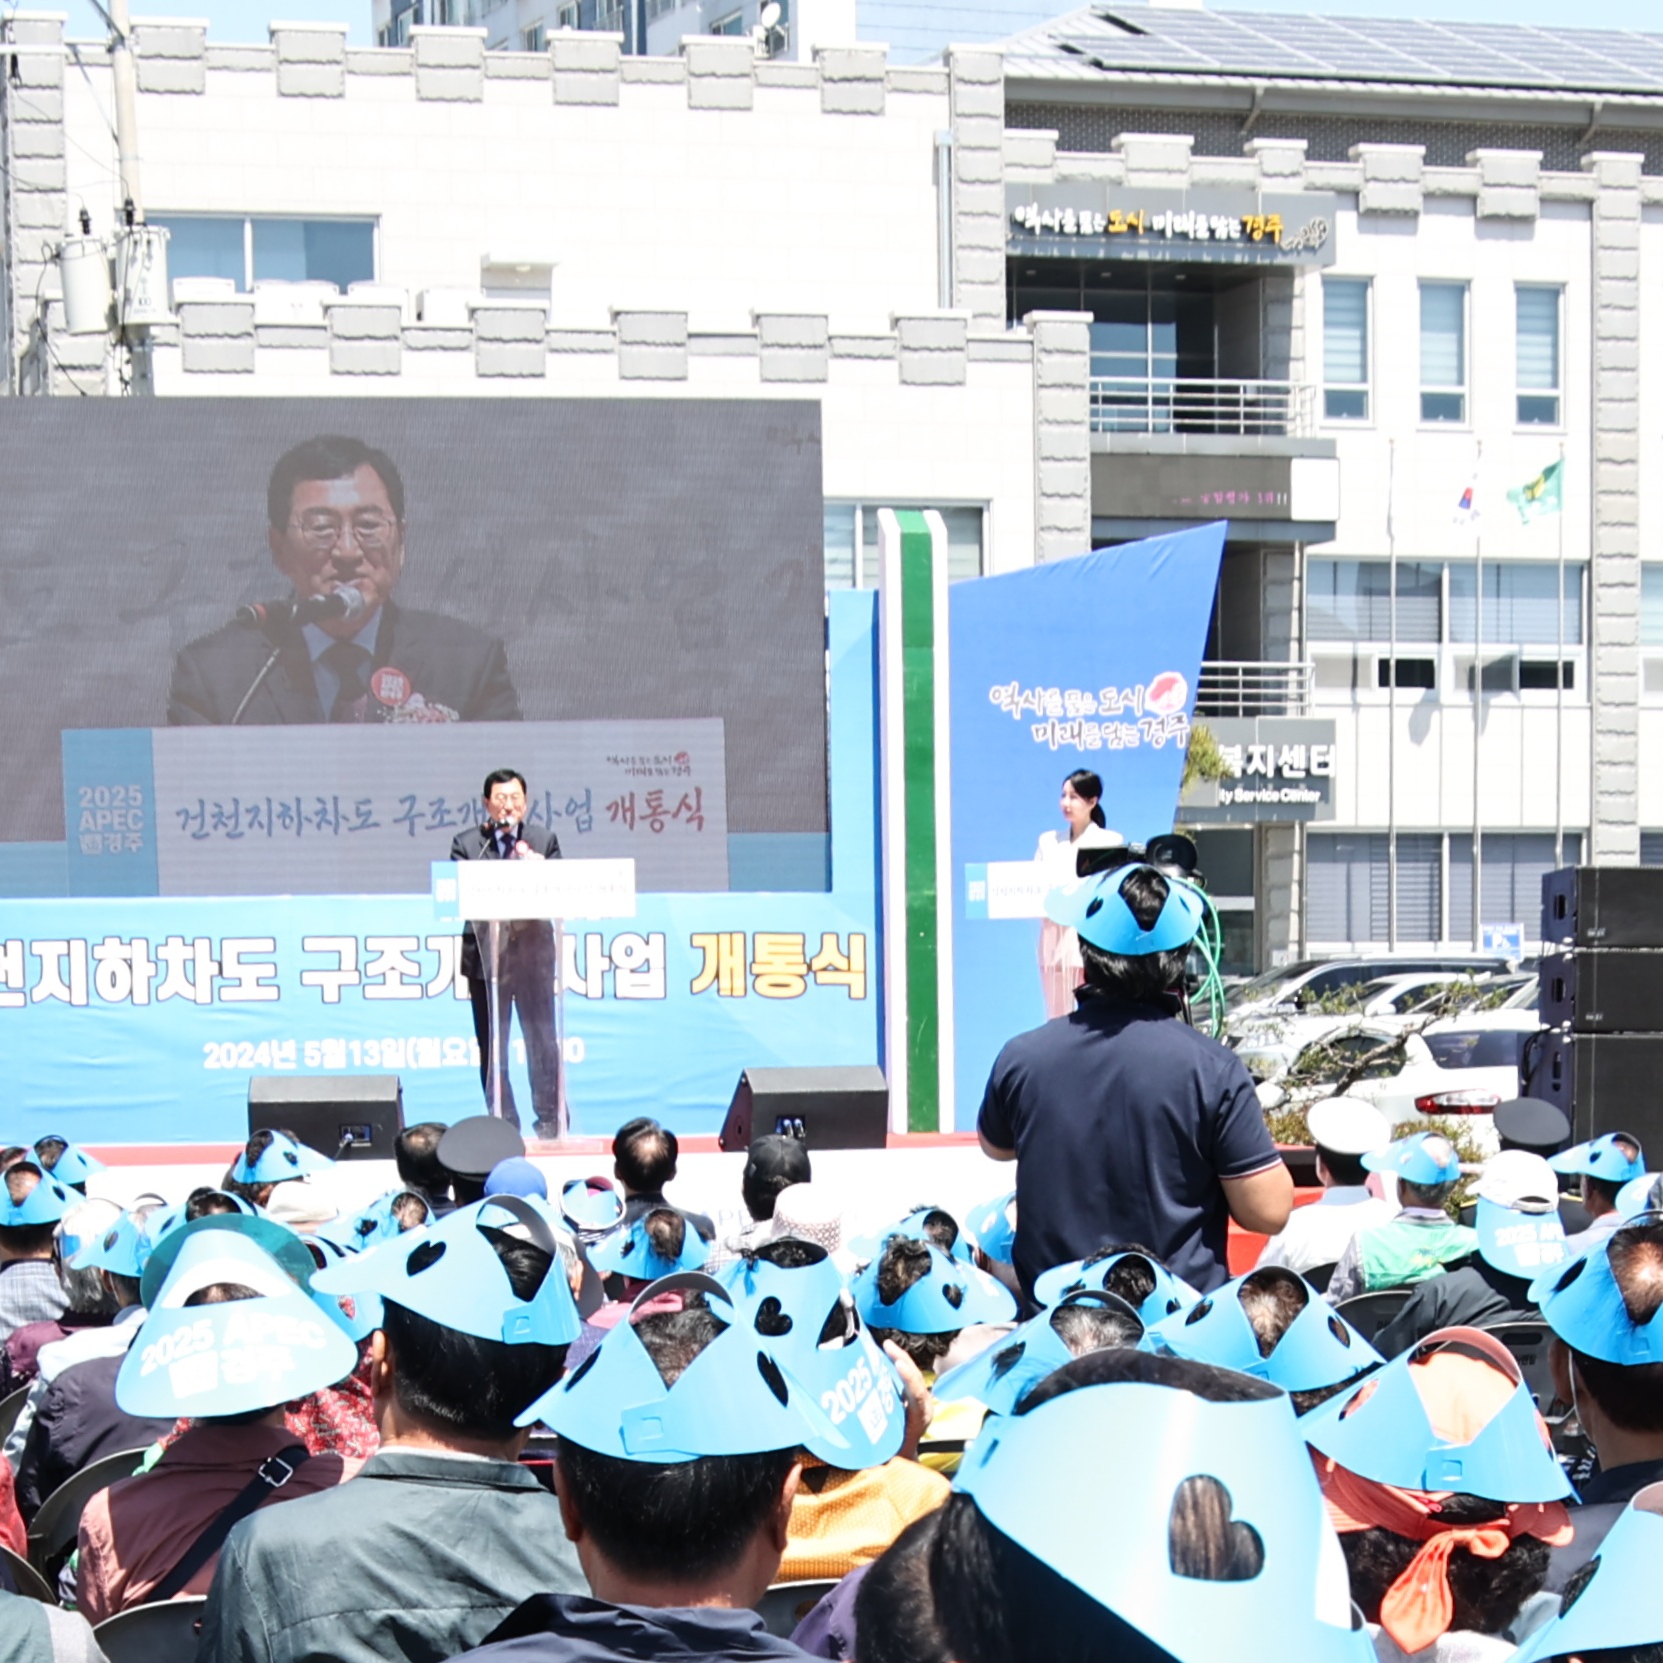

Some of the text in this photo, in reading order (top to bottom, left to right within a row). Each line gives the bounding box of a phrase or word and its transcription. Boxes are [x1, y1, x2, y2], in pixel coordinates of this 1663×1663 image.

[1108, 208, 1144, 235] 도시
[1241, 213, 1284, 243] 경주
[1099, 684, 1144, 716] 도시
[1139, 713, 1190, 748] 경주
[78, 785, 143, 808] 2025
[1234, 787, 1280, 803] Service
[1281, 787, 1321, 803] Center
[78, 809, 144, 832] APEC
[175, 786, 706, 840] 건천지하차도 구조개사업 개통식
[105, 832, 144, 853] 경주
[300, 931, 667, 1004] 구조개사업
[689, 931, 867, 1000] 개통식
[203, 1038, 297, 1071] 2024년
[140, 1311, 328, 1378] 2025 APEC
[820, 1355, 873, 1425] 2025
